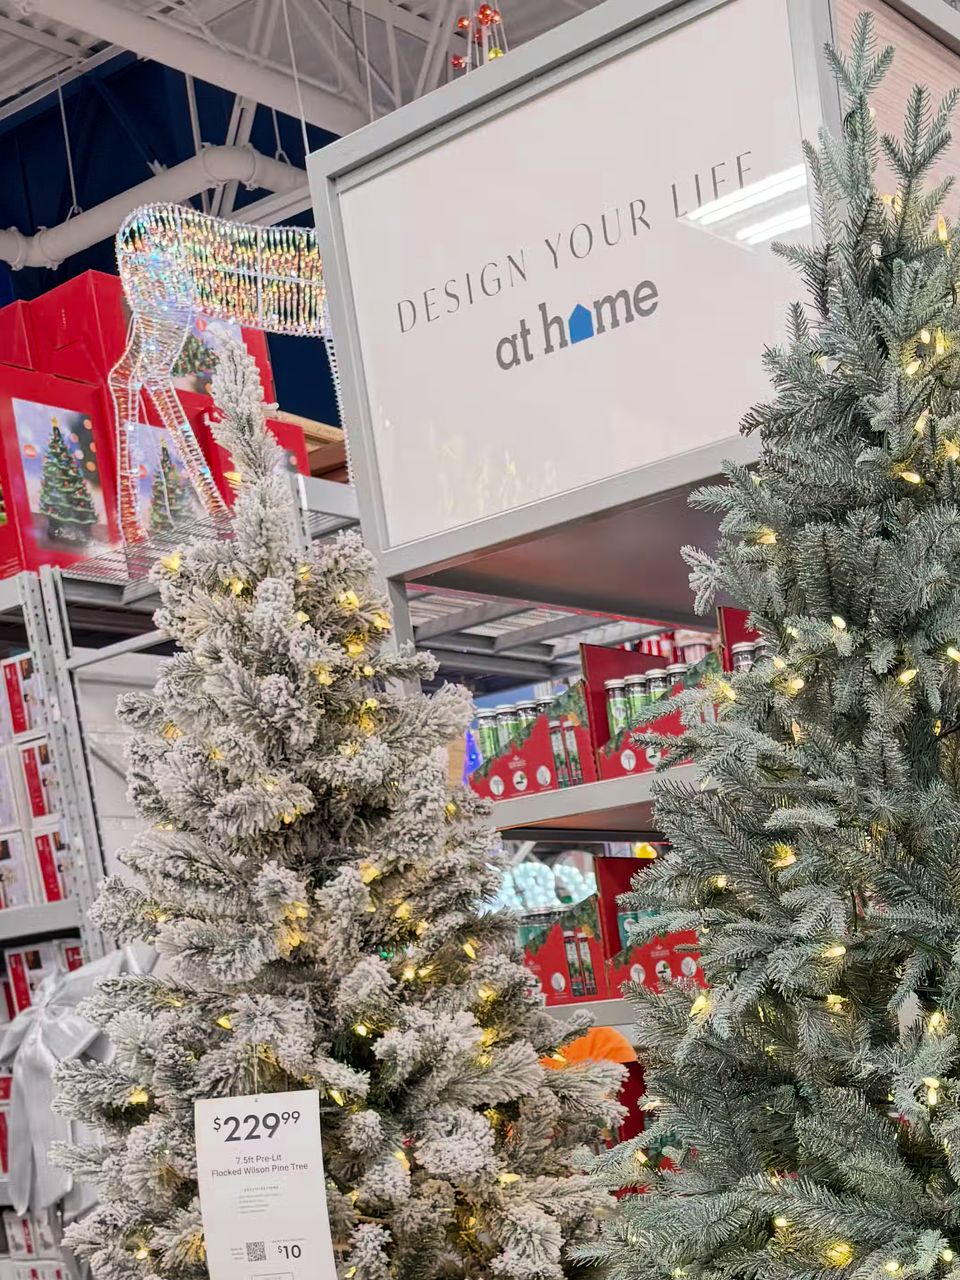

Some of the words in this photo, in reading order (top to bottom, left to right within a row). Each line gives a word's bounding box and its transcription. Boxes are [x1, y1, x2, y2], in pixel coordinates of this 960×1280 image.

[396, 249, 529, 333] DESIGN
[543, 198, 652, 270] YOUR
[495, 318, 534, 371] at
[255, 1153, 282, 1163] Pre-Lit
[211, 1167, 242, 1177] Flocked
[243, 1166, 270, 1175] Wilson
[271, 1164, 289, 1173] Pine
[290, 1162, 308, 1171] Tree
[277, 1244, 302, 1260] $10
